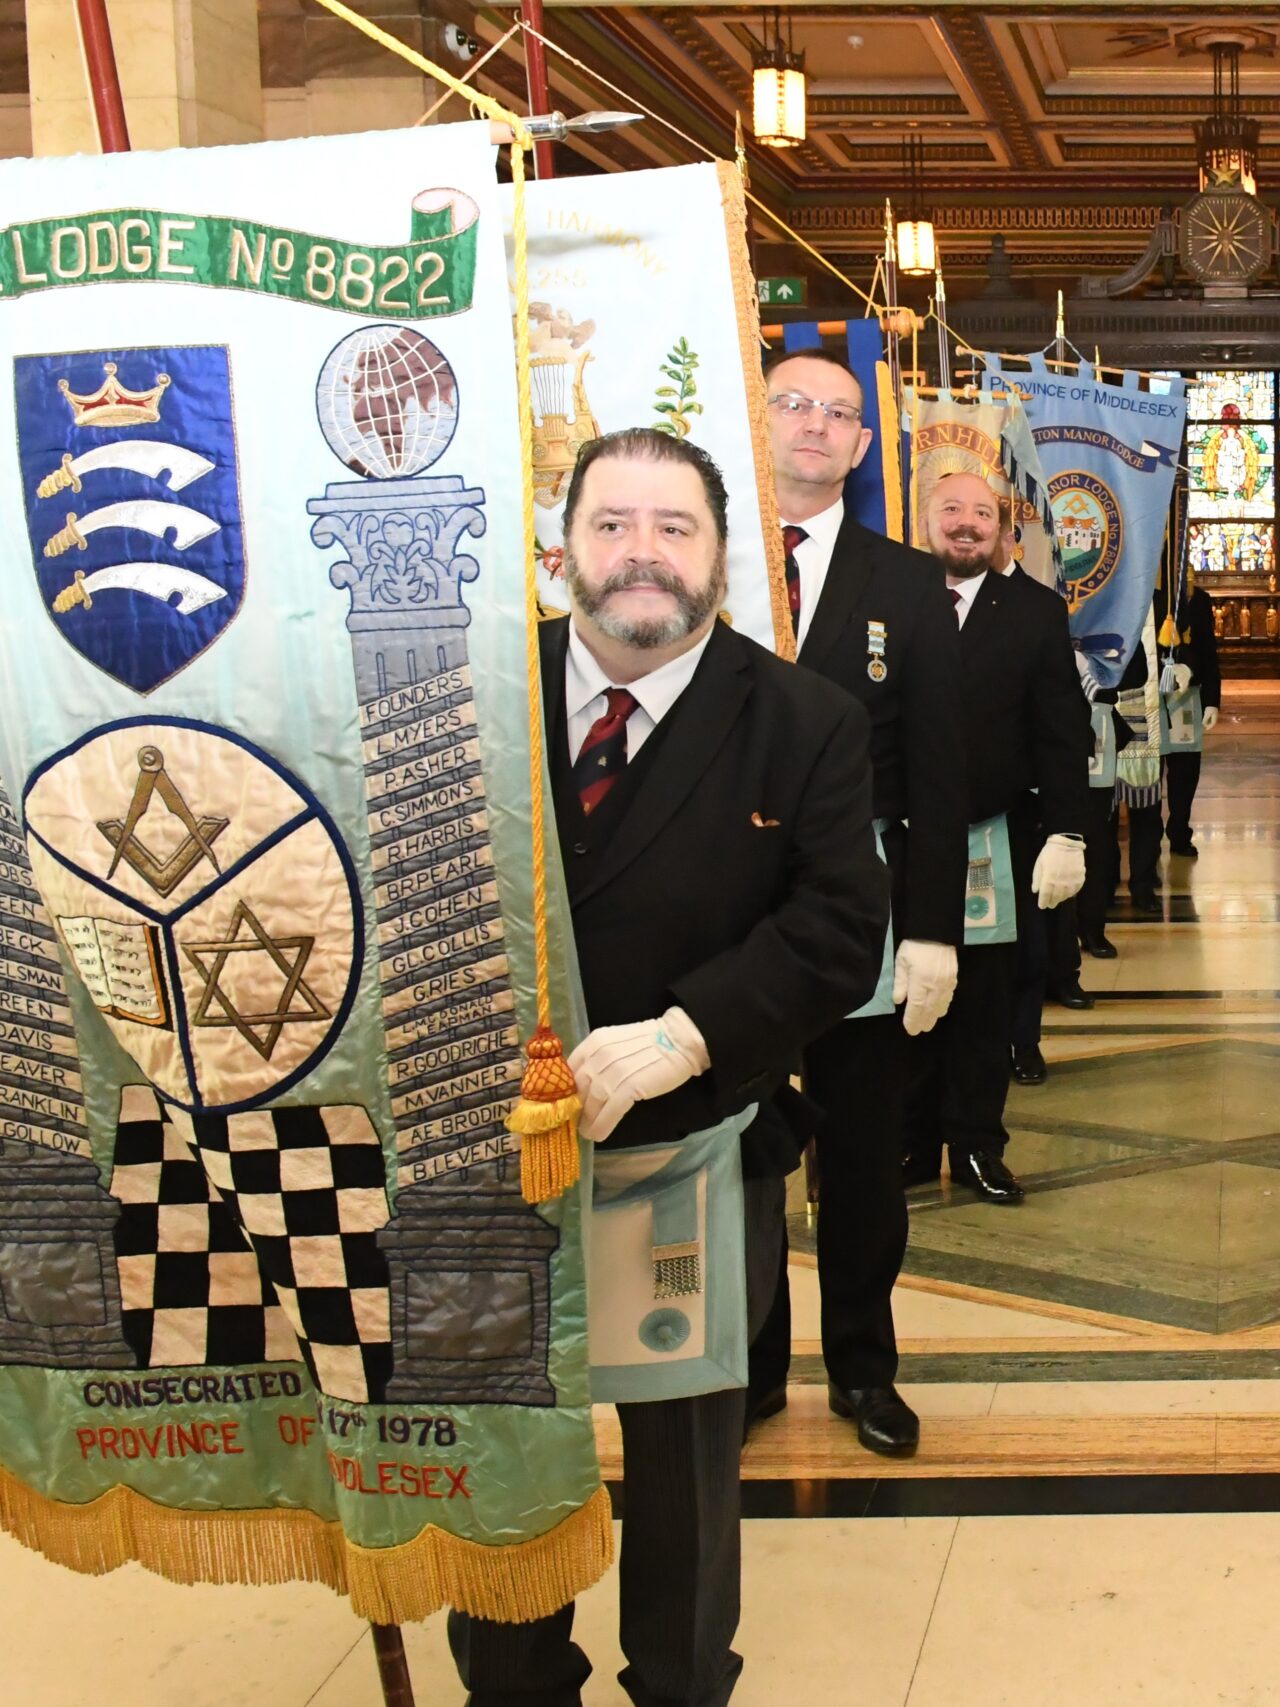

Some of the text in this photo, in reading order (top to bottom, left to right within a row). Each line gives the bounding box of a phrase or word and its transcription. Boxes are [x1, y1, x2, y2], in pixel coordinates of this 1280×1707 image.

[13, 218, 196, 285] LODGE
[305, 245, 451, 309] 8822
[1070, 387, 1090, 401] OF
[1094, 388, 1178, 419] MIDDLESEX
[1062, 428, 1109, 447] MANOR
[1111, 439, 1145, 470] LODGE
[1084, 477, 1117, 519] LODGE
[1098, 544, 1118, 573] 7882
[366, 671, 463, 722] FOUNDERS
[83, 1371, 301, 1409] CONSECRATED
[77, 1414, 317, 1460] PROVINCE OF
[377, 1415, 457, 1447] 1978
